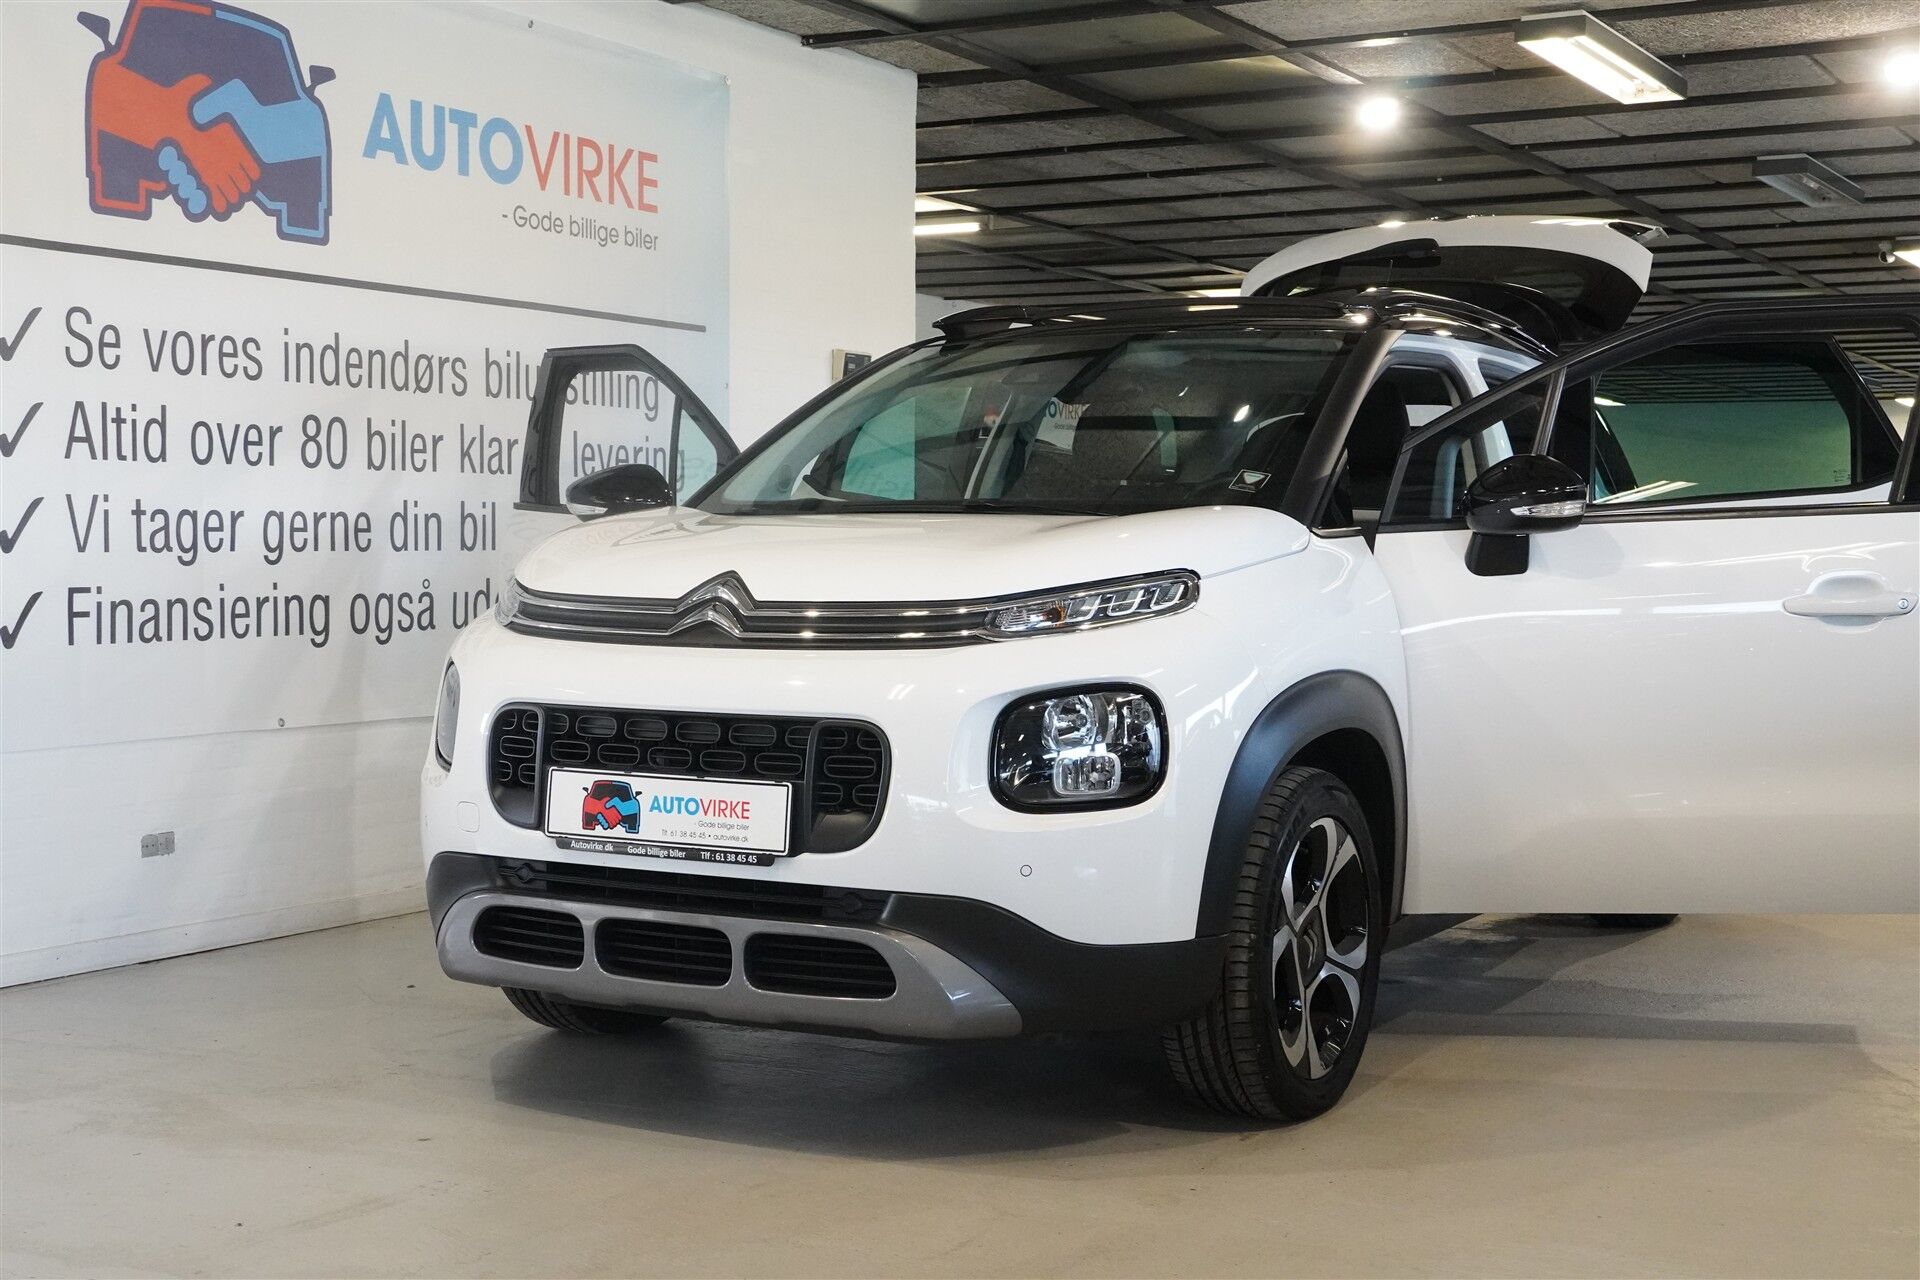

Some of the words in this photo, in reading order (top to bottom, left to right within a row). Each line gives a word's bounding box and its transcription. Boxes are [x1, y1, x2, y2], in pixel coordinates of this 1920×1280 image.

[362, 92, 659, 214] AUTOVIRKE
[513, 204, 564, 234] Gode
[569, 215, 619, 248] billige
[624, 225, 659, 251] biler
[65, 306, 121, 370] Se
[143, 328, 263, 381] vores
[284, 327, 467, 397] indendørs
[485, 347, 659, 422] bilustilling
[64, 400, 168, 463] Altid
[190, 420, 283, 466] over
[301, 414, 348, 470] 80
[366, 417, 444, 473] biler
[459, 423, 519, 475] klar
[65, 494, 110, 553] Vi
[131, 499, 244, 567] tager
[263, 510, 371, 566] gerne
[390, 500, 442, 552] din
[460, 501, 496, 551] bil
[67, 582, 330, 648] Finansiering
[350, 579, 436, 645] også
[452, 577, 501, 630] ud
[649, 795, 750, 819] AUTOVIRKE
[689, 831, 697, 839] 45
[698, 832, 706, 840] 45
[697, 820, 716, 829] Gode
[736, 823, 750, 831] biler
[570, 840, 604, 851] Autovirke
[627, 845, 646, 855] Gode
[647, 847, 668, 858] billige
[669, 849, 686, 858] biler
[715, 852, 725, 861] 61
[726, 853, 736, 862] 38
[736, 854, 747, 863] 45
[747, 855, 758, 863] 45
